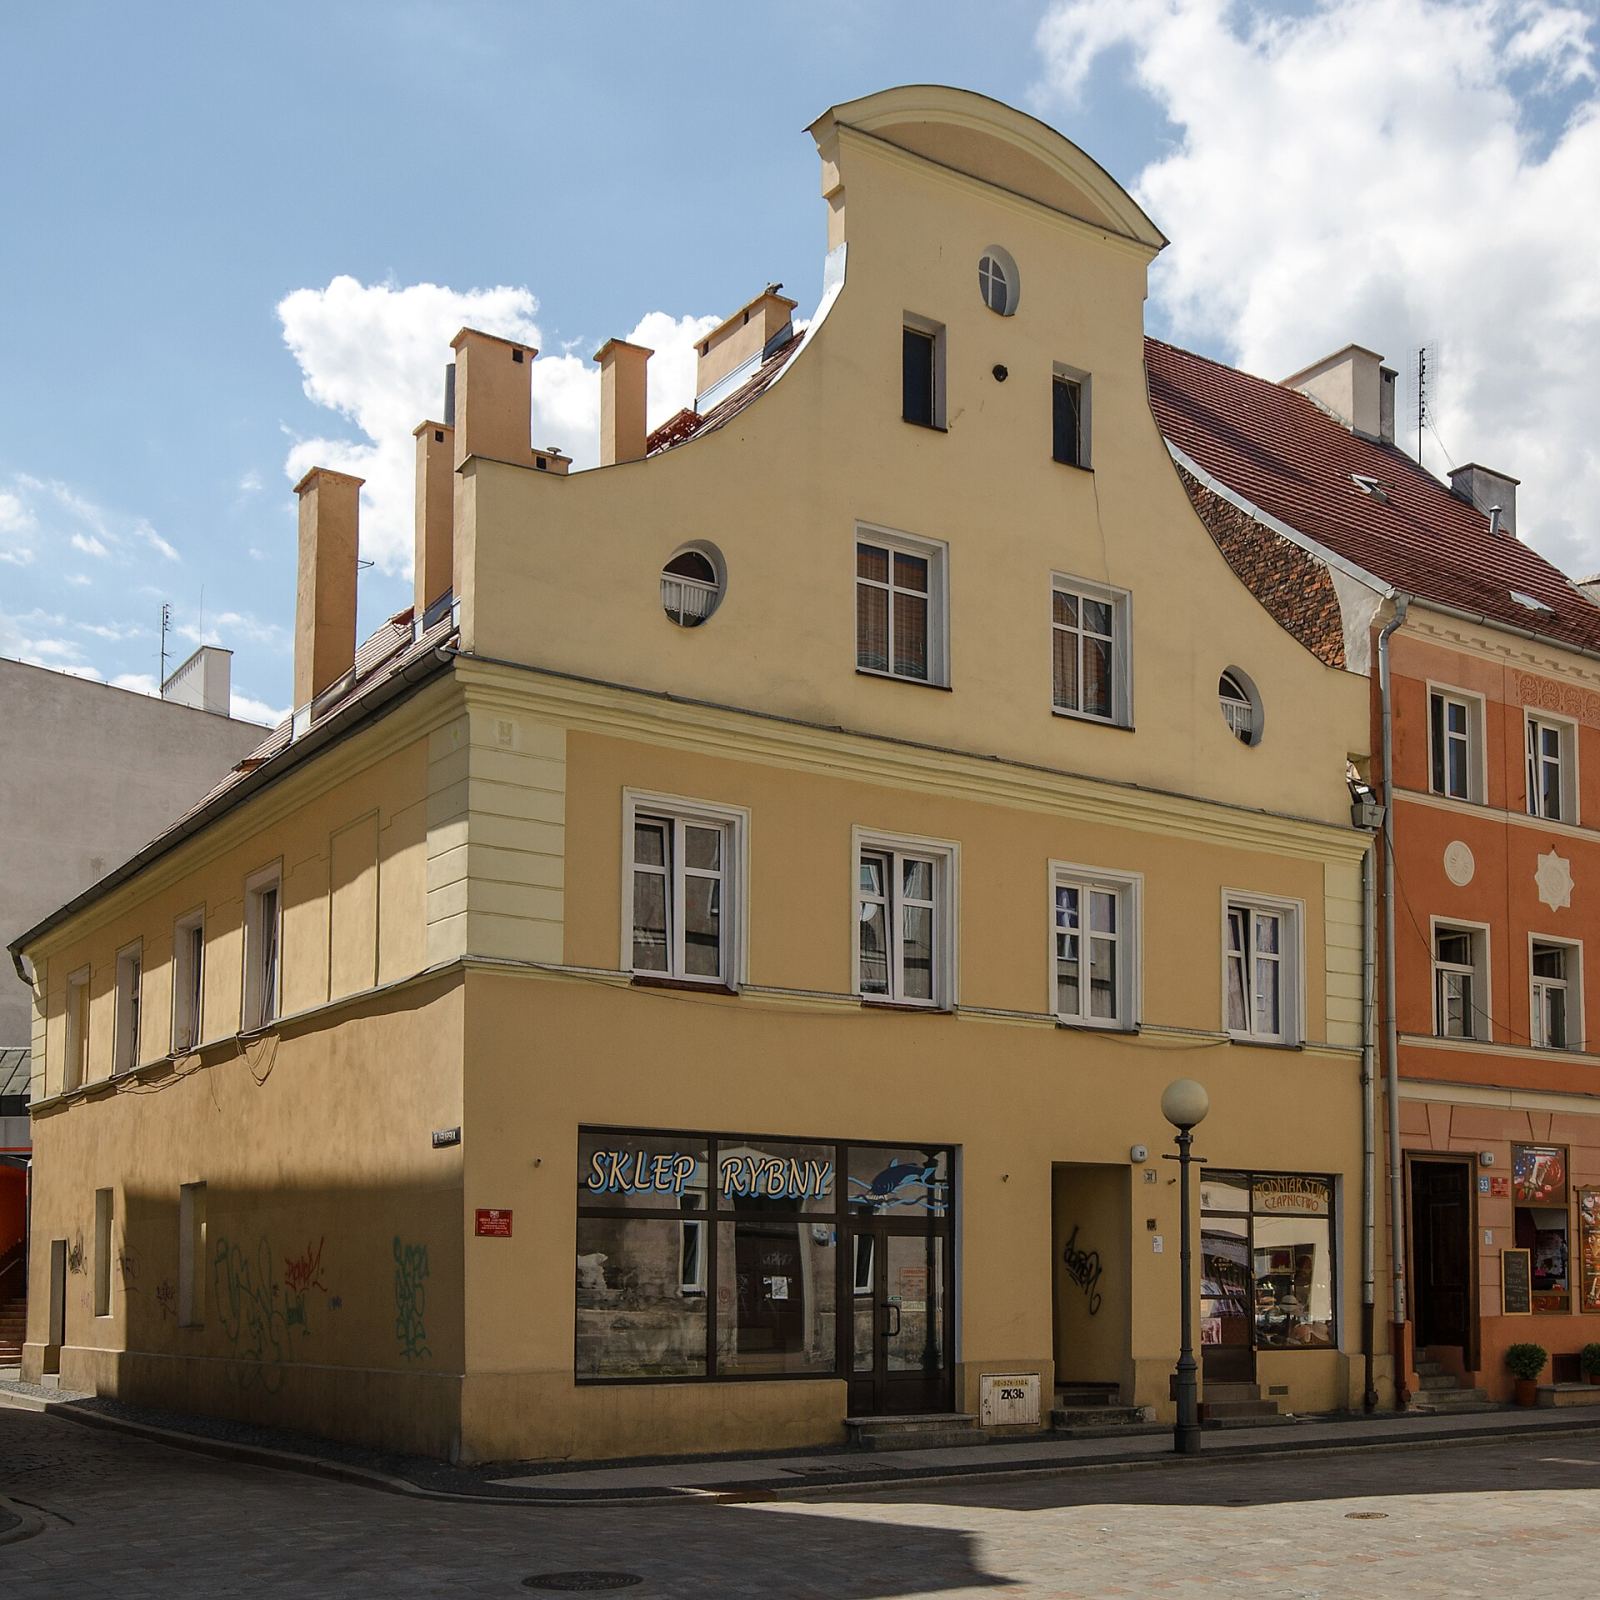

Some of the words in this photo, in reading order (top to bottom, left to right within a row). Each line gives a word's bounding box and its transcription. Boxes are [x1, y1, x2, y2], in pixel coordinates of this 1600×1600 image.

[587, 1151, 696, 1196] SKLEP
[721, 1156, 832, 1199] RYBNY
[1264, 1194, 1319, 1212] CZAPNICTWO
[1001, 1388, 1025, 1400] ZK3b
